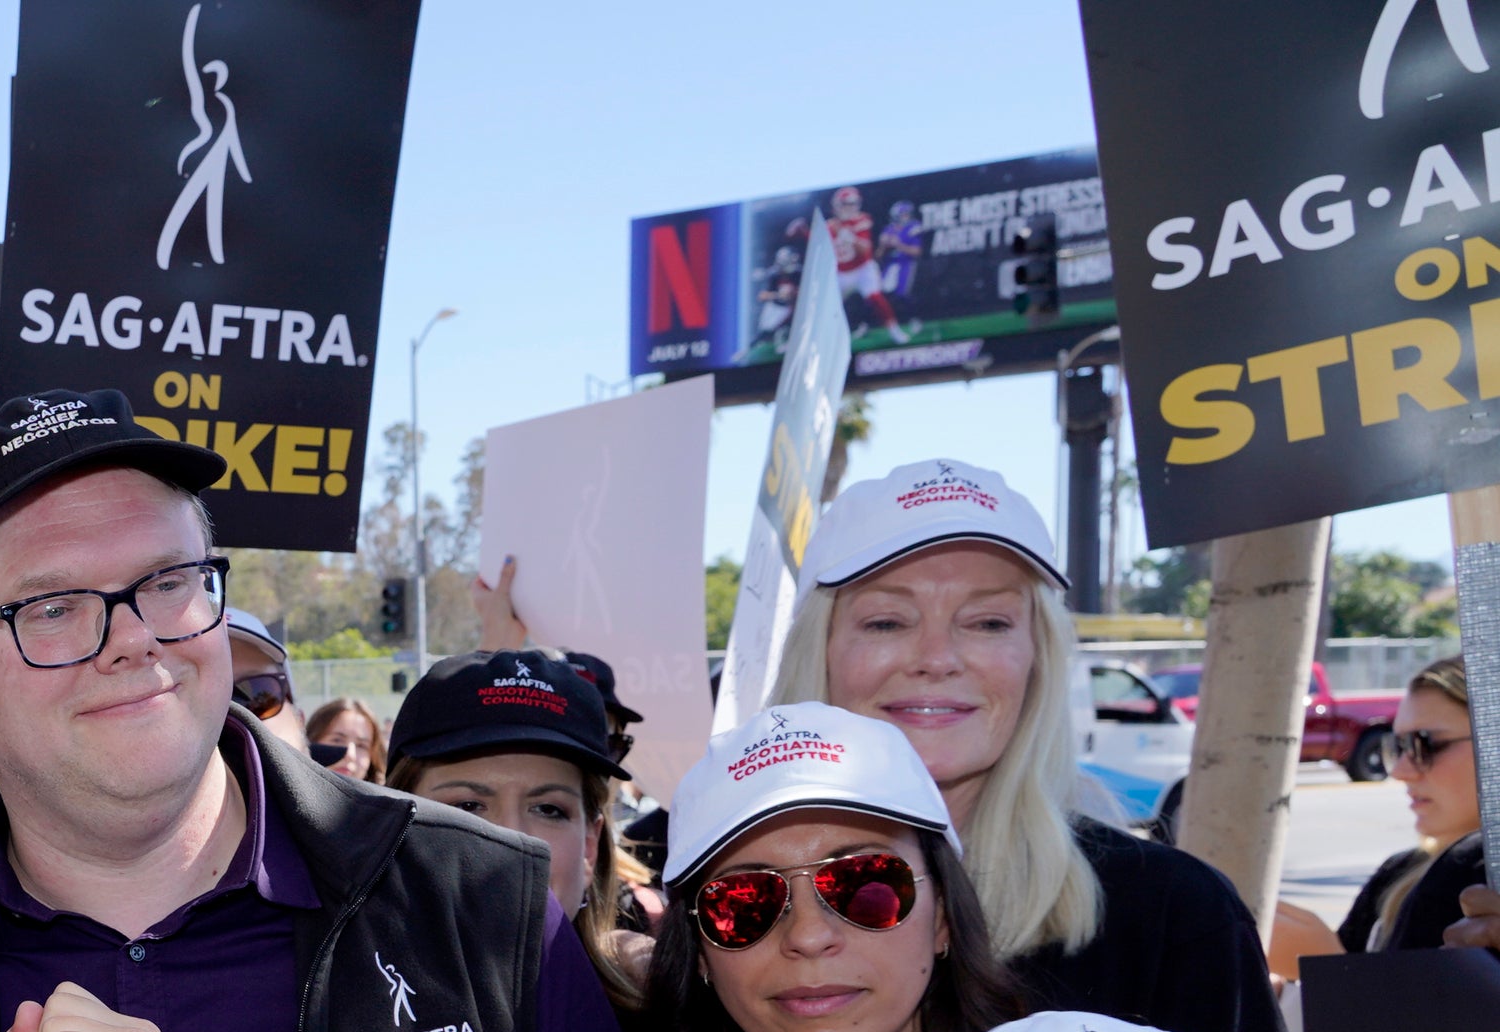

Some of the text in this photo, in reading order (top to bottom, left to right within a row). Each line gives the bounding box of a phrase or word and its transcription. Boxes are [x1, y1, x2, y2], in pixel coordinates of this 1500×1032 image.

[920, 200, 959, 230] THE
[648, 219, 711, 334] N
[1394, 236, 1500, 300] ON
[153, 371, 222, 411] ON
[26, 410, 80, 432] CHIEF
[0, 418, 118, 457] NEGOTIATOR
[897, 486, 998, 504] NEGOTIATING
[903, 495, 996, 511] COMMITTEE
[477, 687, 569, 707] NEGOTIATING
[482, 696, 566, 716] COMMITTEE
[727, 740, 846, 774] NEGOTIATING
[733, 751, 842, 782] COMMITTEE
